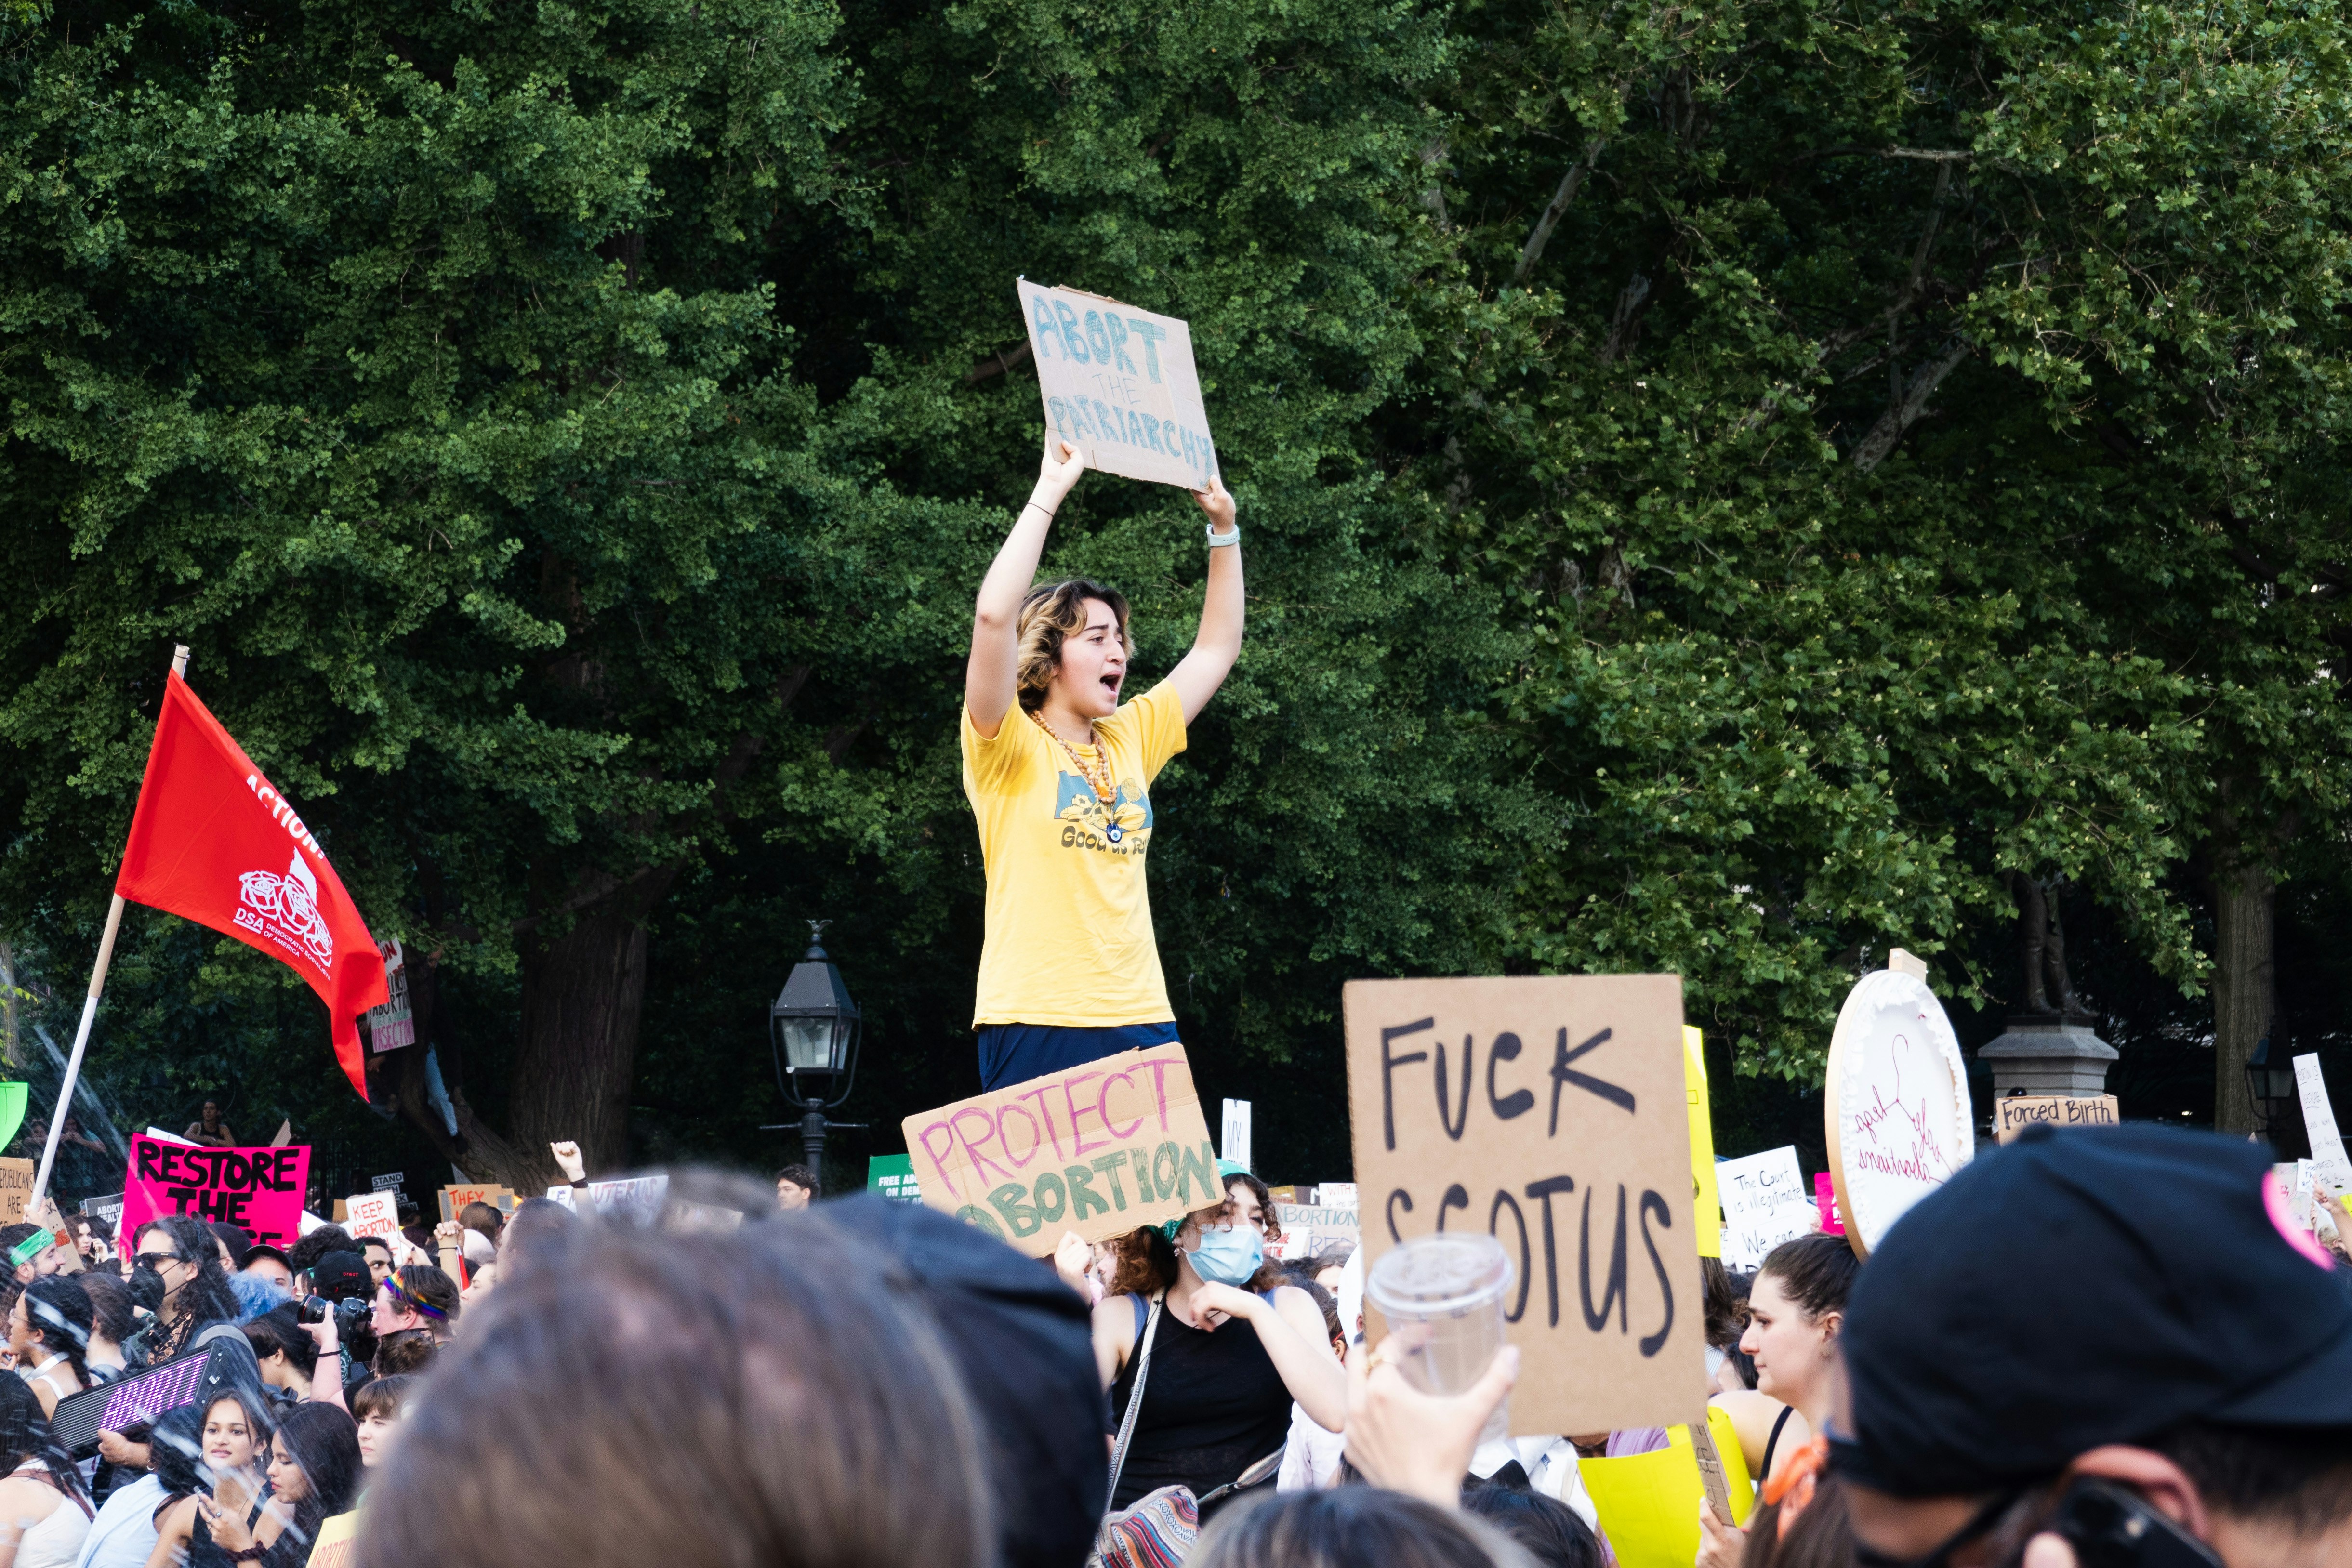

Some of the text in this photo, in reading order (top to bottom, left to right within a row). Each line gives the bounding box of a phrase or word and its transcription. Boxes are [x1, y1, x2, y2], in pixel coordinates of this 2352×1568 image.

[1033, 295, 1166, 384] ABORT
[1092, 373, 1141, 405] THE
[1048, 395, 1214, 487] PATRIARCHY
[235, 908, 264, 930] DSA
[264, 931, 300, 957] OF AMERICA
[266, 923, 330, 981] DEMOCRATIC SOCIALISTS
[1381, 1016, 1635, 1151] FUCK
[2002, 1099, 2113, 1130] Forced Birth
[919, 1059, 1186, 1201] PROTECT
[1227, 1120, 1242, 1158] MY
[137, 1141, 300, 1192] RESTORE
[373, 1173, 403, 1186] STAND
[1734, 1163, 1791, 1190] The Court
[0, 1168, 34, 1193] EPUBLICANS
[594, 1178, 657, 1205] UTERUS
[878, 1175, 900, 1186] FREE
[885, 1186, 921, 1197] ON DEM
[955, 1140, 1216, 1242] ABORTION
[1327, 1184, 1351, 1195] WITH
[7, 1194, 21, 1215] ARE
[97, 1202, 123, 1215] ABORTI
[166, 1187, 253, 1227] THE
[353, 1200, 383, 1221] KEEP
[449, 1189, 485, 1206] THEY
[1734, 1183, 1803, 1216] is illegitimate
[100, 1212, 121, 1223] EALT
[354, 1217, 396, 1239] ABORTION
[1742, 1230, 1767, 1254] We
[1775, 1230, 1796, 1245] can
